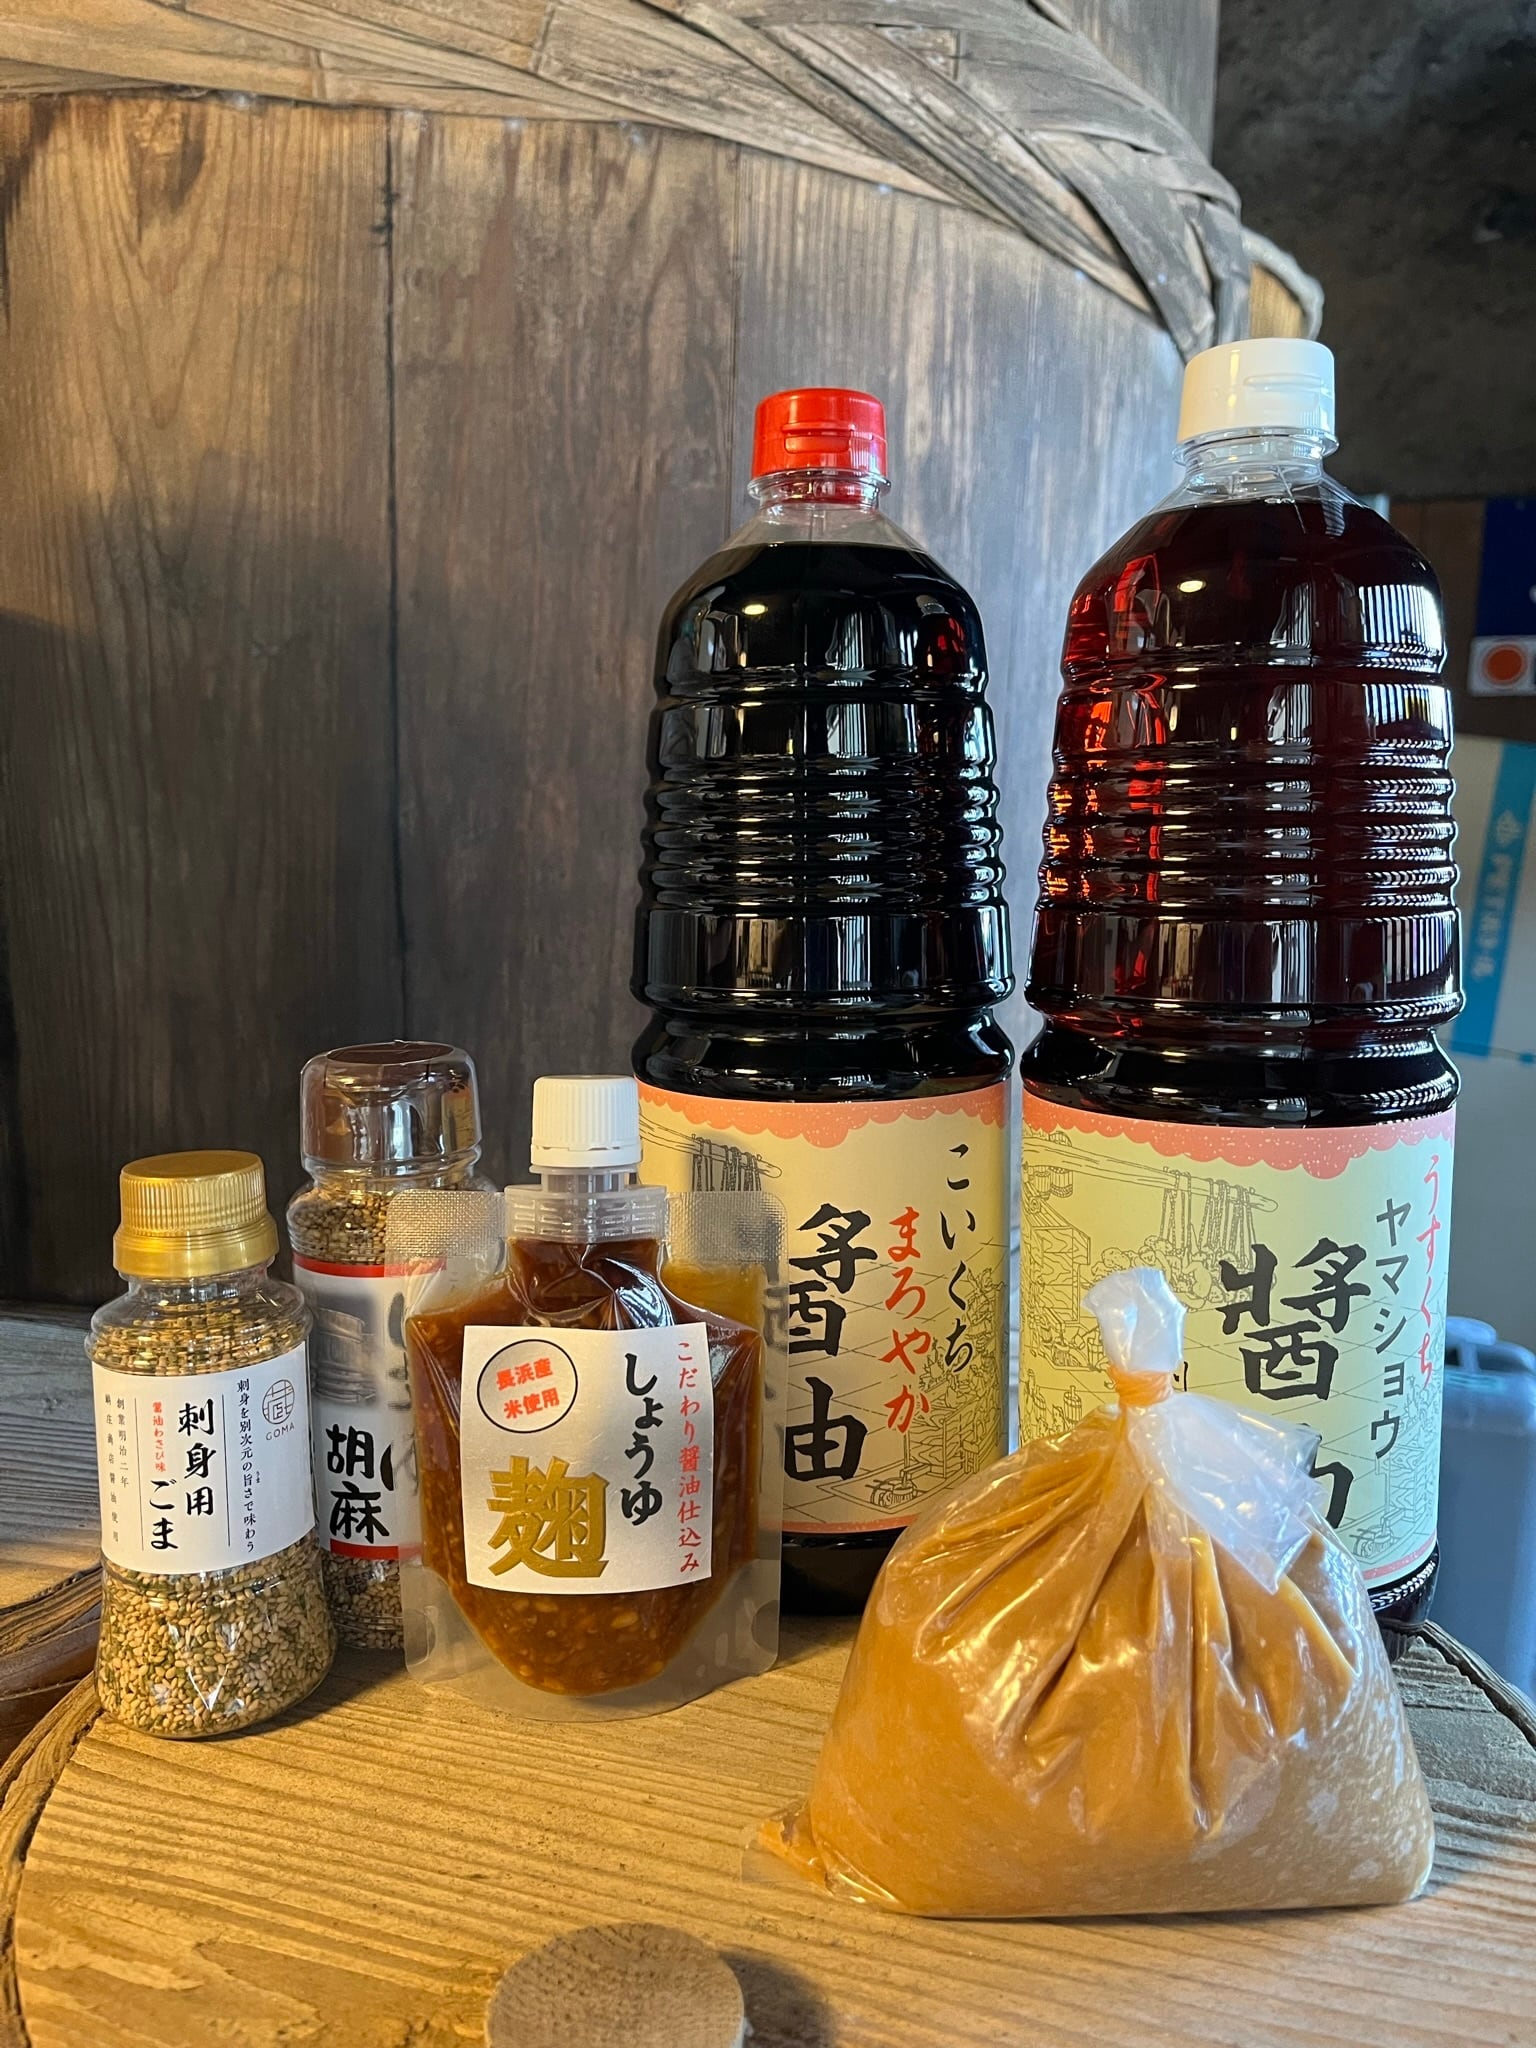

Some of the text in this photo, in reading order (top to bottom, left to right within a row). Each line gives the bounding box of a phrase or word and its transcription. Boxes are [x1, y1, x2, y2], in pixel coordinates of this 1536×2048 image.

[880, 1205, 932, 1435] まろやか
[939, 1143, 976, 1374] こいくち
[1416, 1154, 1441, 1391] うすくち
[177, 1398, 217, 1516] 刺身用
[265, 1422, 296, 1441] GOMA
[495, 1357, 554, 1391] 長浜産
[503, 1387, 561, 1419] 米使用
[620, 1352, 665, 1526] しょうゆ
[677, 1342, 702, 1574] こだわり醤油仕込み
[1216, 1237, 1372, 1530] 醤
[149, 1477, 179, 1550] ごま
[236, 1378, 257, 1554] 刺身を別次元の旨さで味わう
[325, 1423, 390, 1545] 胡麻
